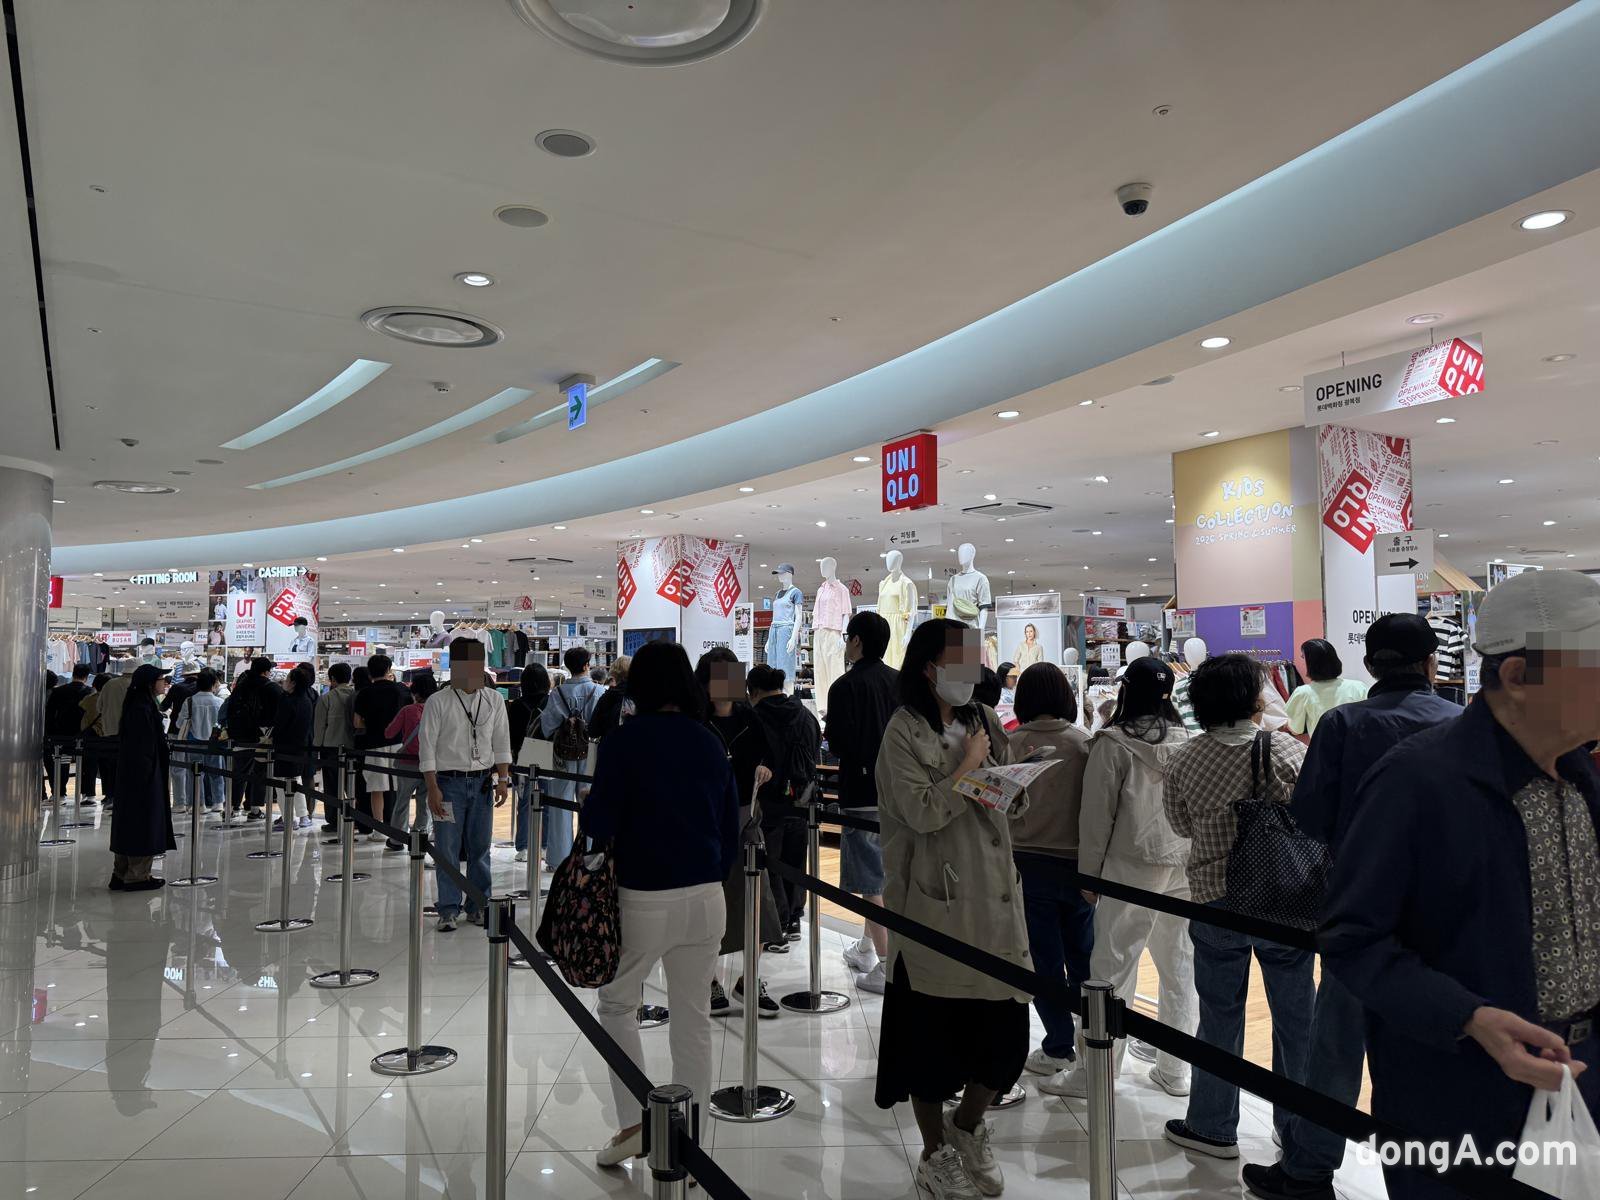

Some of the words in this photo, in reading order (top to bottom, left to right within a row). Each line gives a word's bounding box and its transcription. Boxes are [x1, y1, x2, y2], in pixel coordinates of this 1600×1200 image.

[1452, 345, 1484, 381] UNI
[1316, 373, 1382, 401] OPENING
[886, 445, 916, 475] UNI
[886, 473, 919, 506] QLO
[1222, 476, 1264, 500] KIDS
[1196, 502, 1294, 530] COLLECTION
[1333, 482, 1368, 528] QLO
[138, 572, 171, 584] FITTING
[172, 571, 197, 583] ROOM
[259, 566, 298, 578] CASHIER
[724, 563, 738, 596] UNI
[272, 594, 294, 616] QLO
[717, 576, 732, 609] QLO
[236, 598, 256, 618] UT
[703, 640, 730, 649] OPENING
